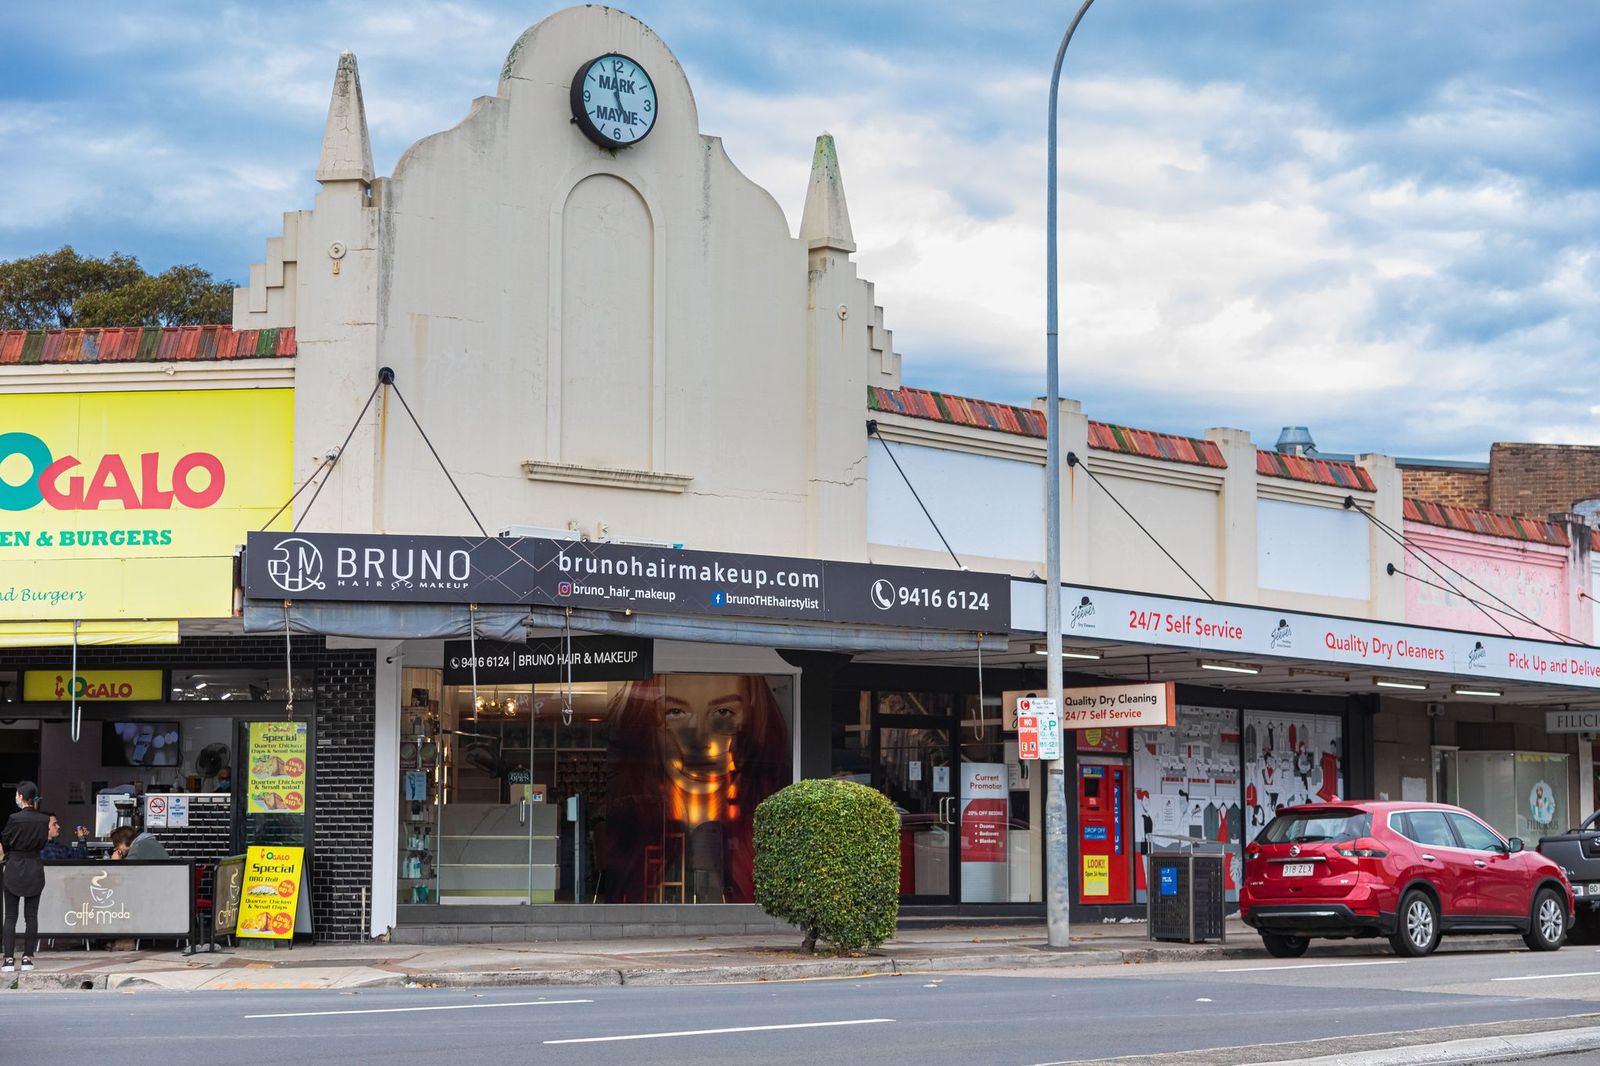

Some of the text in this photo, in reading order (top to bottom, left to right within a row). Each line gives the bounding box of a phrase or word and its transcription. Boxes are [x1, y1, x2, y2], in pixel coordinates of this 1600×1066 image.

[612, 60, 624, 74] 12
[598, 74, 636, 94] MARK
[583, 90, 591, 102] 9
[643, 100, 652, 112] 3
[596, 105, 638, 126] MAYNE
[613, 128, 622, 140] 6
[36, 531, 54, 547] &
[59, 529, 173, 547] BURGERS
[336, 547, 471, 581] BRUNO
[558, 550, 820, 589] brunohairmakeup.com
[337, 580, 383, 588] HAIR
[573, 583, 676, 602] bruno_hair_makeup
[20, 587, 87, 606] Burgers
[725, 592, 820, 610] brunoTHEhairstylist
[898, 586, 990, 611] 9416 6124
[1128, 609, 1244, 640] 24/7 Self Service
[1324, 631, 1446, 661] Quality Dry Cleaners
[486, 656, 510, 668] 6124
[518, 650, 638, 666] BRUNO HAIR & MAKEUP
[1508, 652, 1530, 671] Pick
[1532, 655, 1547, 676] Up
[1550, 658, 1568, 674] and
[67, 676, 133, 699] OGALO
[1064, 697, 1096, 708] Quality
[1099, 696, 1115, 708] Dry
[1118, 694, 1158, 705] Cleaning
[1065, 708, 1142, 721] 24/7 Self Service
[1556, 715, 1600, 728] FILICI
[975, 774, 1000, 782] Current
[252, 864, 295, 875] Special
